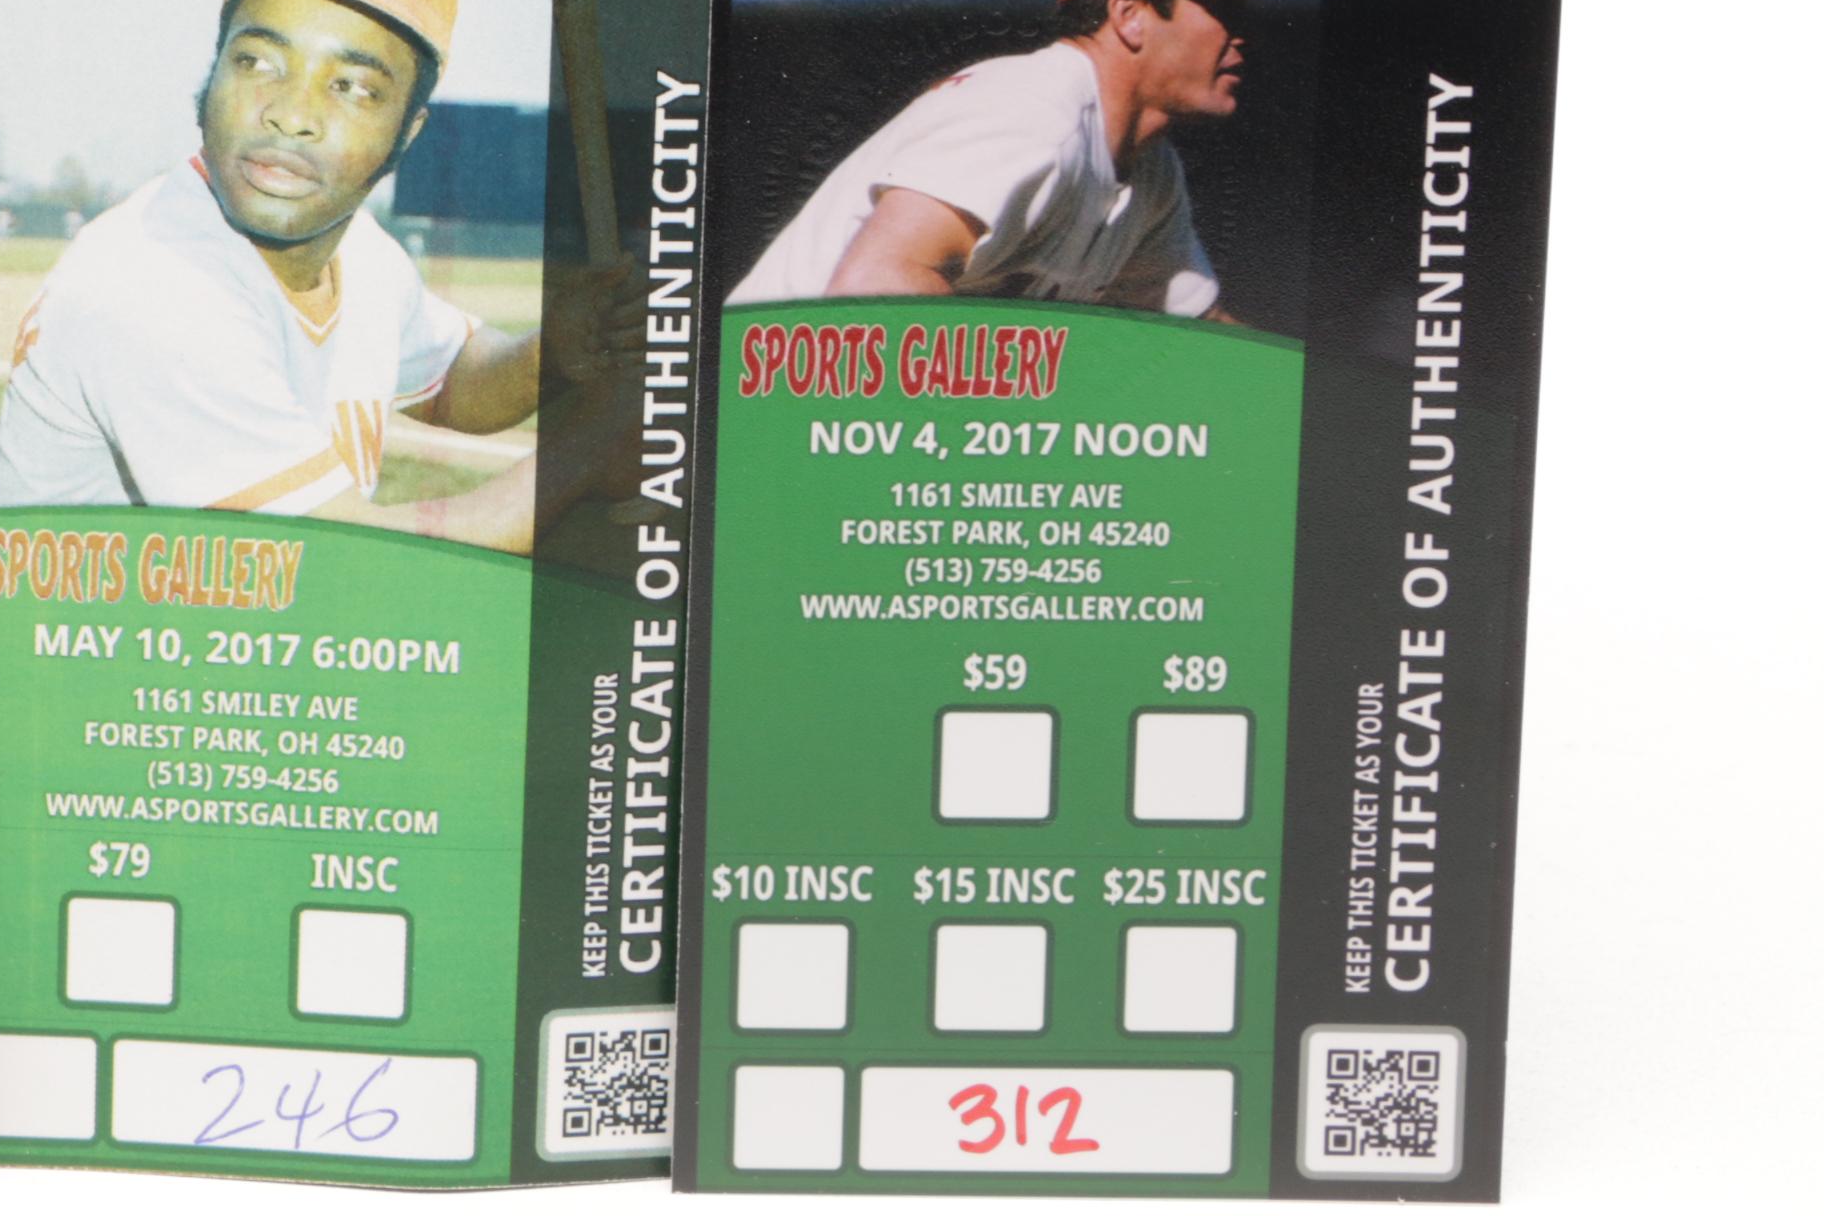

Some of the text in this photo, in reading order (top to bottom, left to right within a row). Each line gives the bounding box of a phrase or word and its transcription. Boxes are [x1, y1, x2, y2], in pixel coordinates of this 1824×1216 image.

[739, 323, 1069, 400] SPORTS GALLERY
[810, 420, 1208, 460] NOV 4, 2017 NOON
[890, 482, 1123, 509] 1161 SMILEY AVE
[619, 71, 701, 973] CERTIFICATE OF AUTHENTICITY
[841, 519, 1171, 549] FOREST PARK, OH 45240
[1384, 73, 1473, 992] CERTIFICATE OF AUTHENTICITY
[138, 529, 304, 612] GALLERY
[904, 557, 1102, 587] (513) 759-4256
[800, 594, 1204, 622] WWW.ASPORTSGALLERY.COM
[35, 623, 460, 674] MAY 10, 2017 6:00PM
[963, 653, 1027, 692] $59
[1163, 654, 1228, 693] $89
[133, 687, 359, 721] 1161 SMILEY AVE
[85, 721, 406, 761] FOREST PARK, OH 45240
[148, 760, 340, 794] (513) 759-4256
[46, 792, 439, 835] WWW.ASPORTSGALLERY.COM
[582, 673, 618, 977] KEEP THIS TICKET AS YOUR
[1345, 683, 1384, 993] KEEP THIS TICKET AS YOUR
[89, 841, 151, 878] $79
[311, 853, 399, 893] INSC
[712, 863, 874, 902] $10 INSC
[913, 866, 1076, 904] $15 INSC
[1103, 867, 1267, 906] $25 INSC
[193, 1058, 399, 1149] 246
[947, 1082, 1101, 1158] 312
